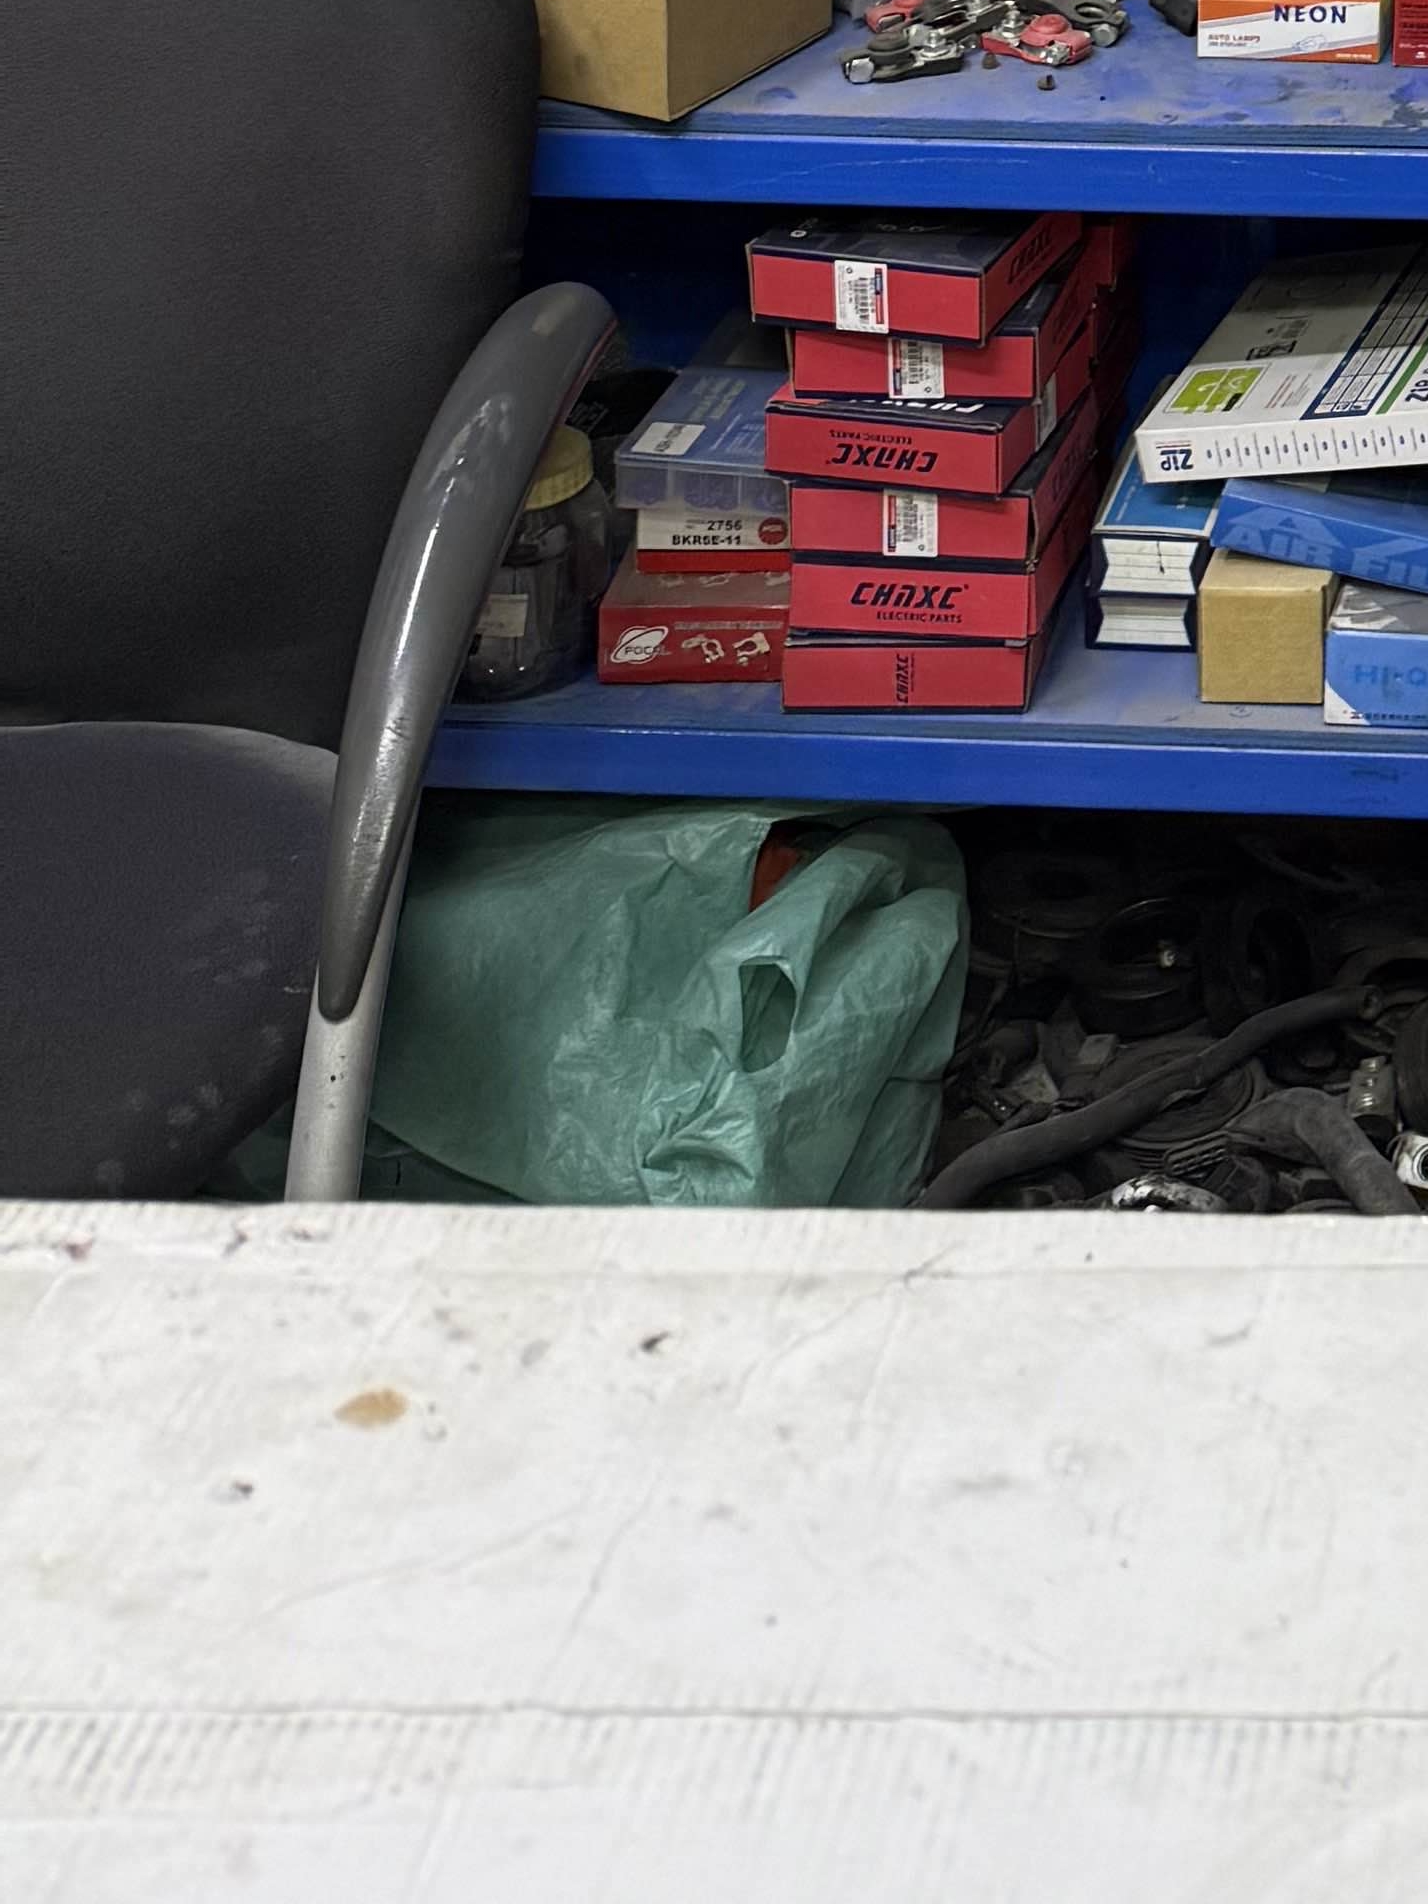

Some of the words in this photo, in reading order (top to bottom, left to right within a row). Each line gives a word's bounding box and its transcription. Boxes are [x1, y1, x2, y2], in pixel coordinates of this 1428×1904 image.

[1273, 3, 1347, 24] NEON
[707, 518, 743, 532] 2756
[1232, 522, 1334, 567] AIR
[876, 610, 926, 623] ELECTRIC
[928, 612, 962, 625] PARTS
[624, 645, 673, 657] FOCAL
